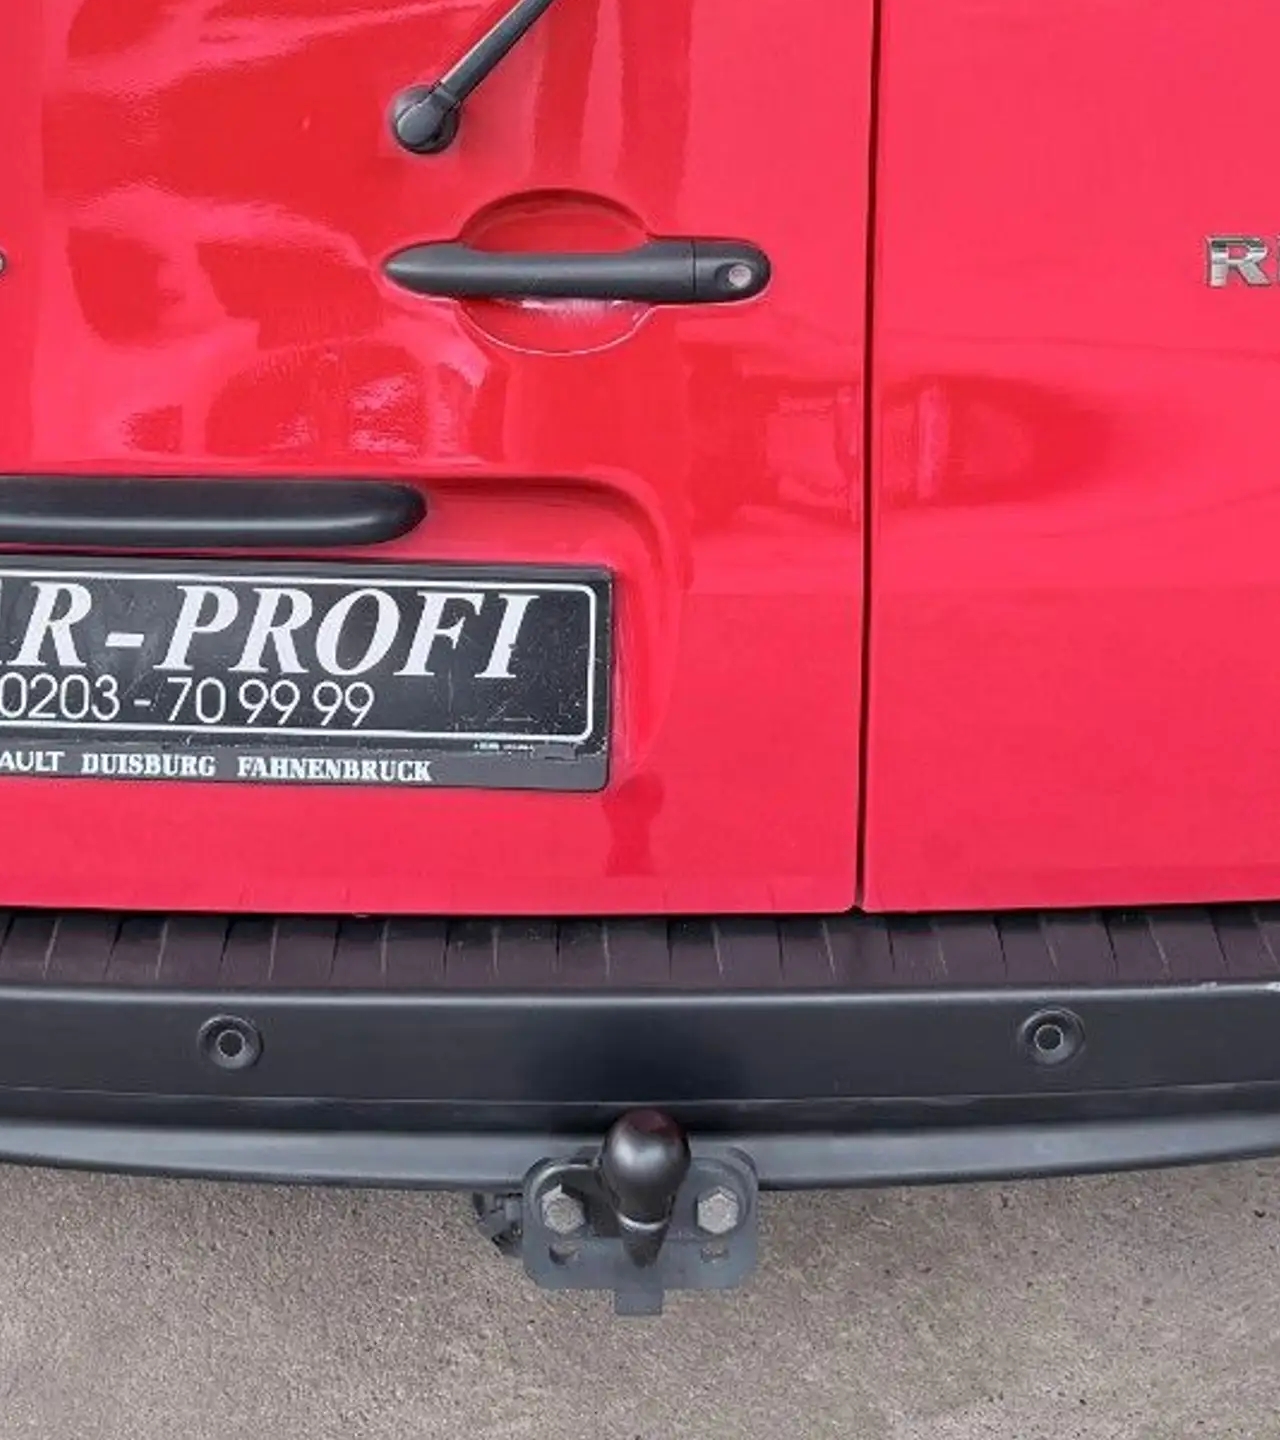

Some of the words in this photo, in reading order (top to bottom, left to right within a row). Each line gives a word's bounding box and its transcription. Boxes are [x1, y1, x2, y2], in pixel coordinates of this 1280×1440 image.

[167, 676, 227, 724] 70
[80, 753, 216, 777] DUISBURG
[236, 756, 431, 782] FAHNENBRUCK
